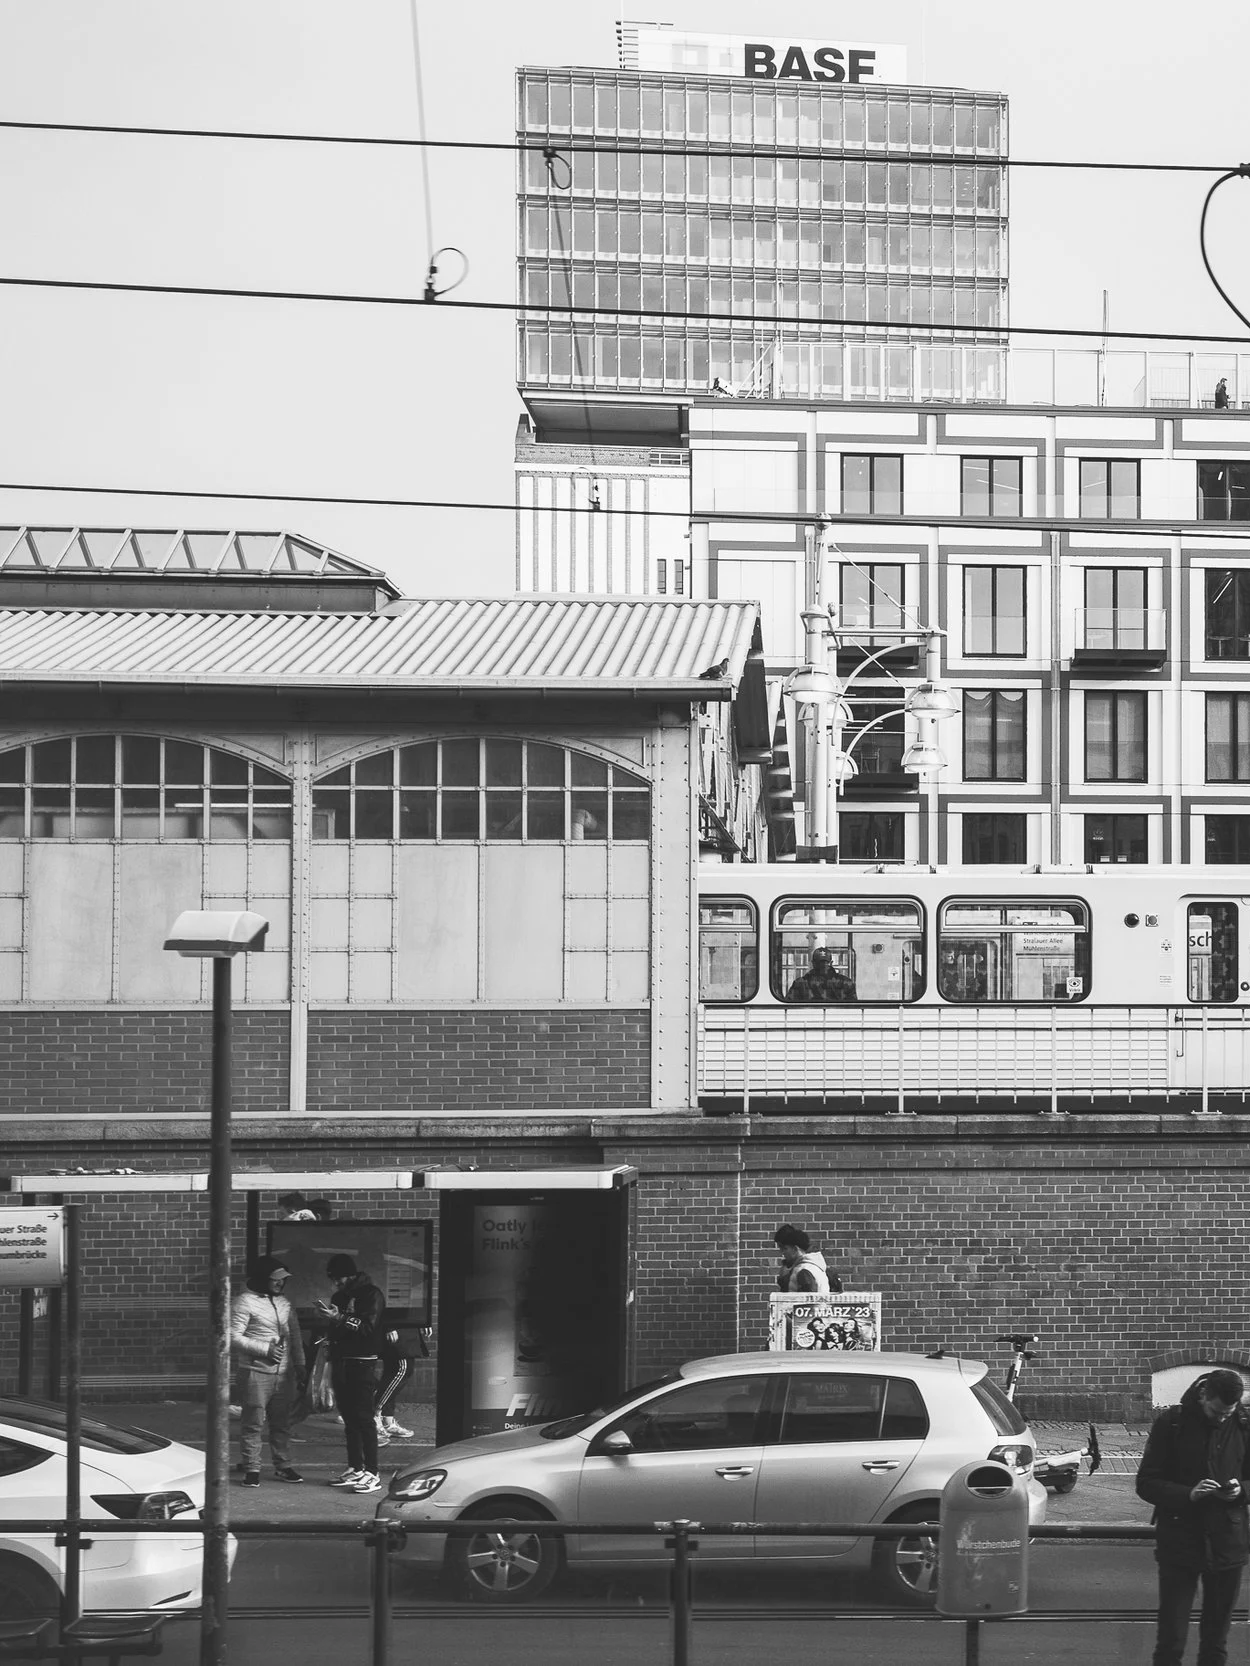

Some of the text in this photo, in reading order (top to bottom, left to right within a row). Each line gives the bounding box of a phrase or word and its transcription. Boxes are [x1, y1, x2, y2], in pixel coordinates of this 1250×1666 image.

[744, 43, 876, 84] BASF
[17, 1223, 48, 1234] Straße
[482, 1219, 527, 1234] Oatly
[795, 1307, 813, 1318] 07.
